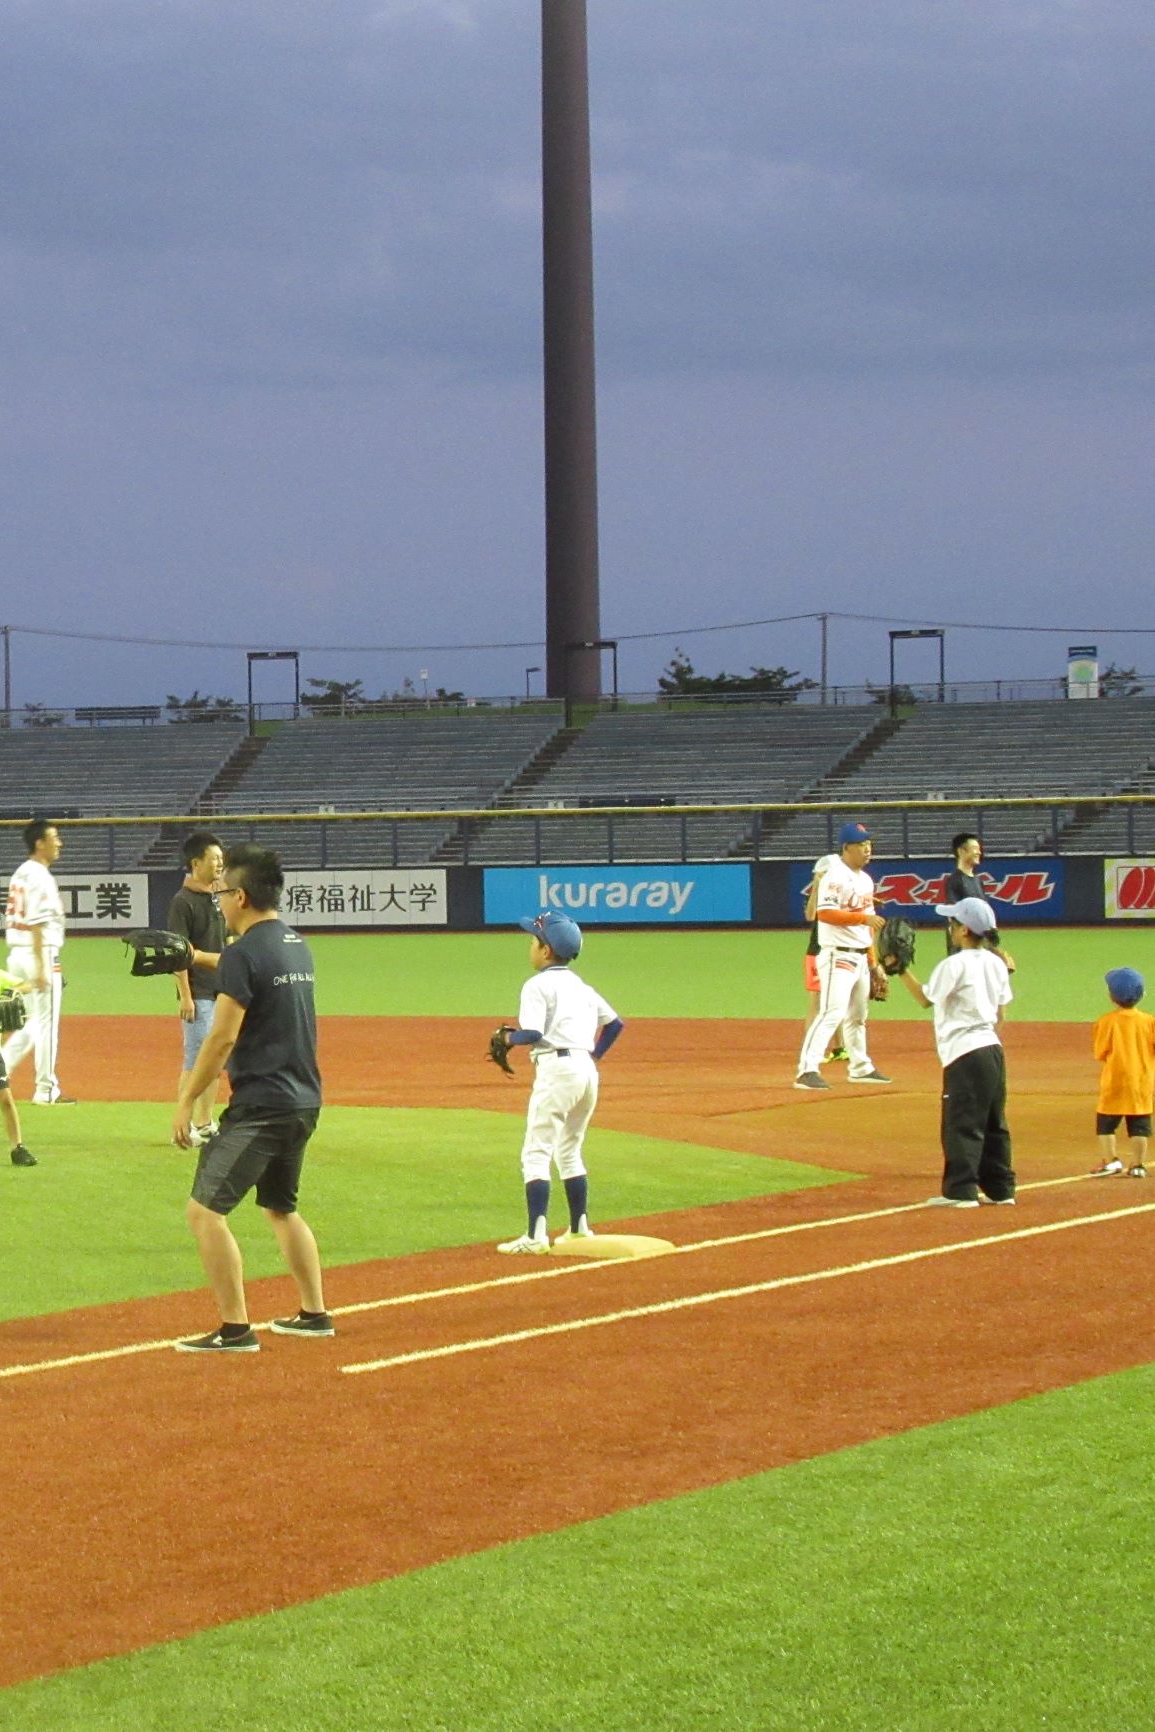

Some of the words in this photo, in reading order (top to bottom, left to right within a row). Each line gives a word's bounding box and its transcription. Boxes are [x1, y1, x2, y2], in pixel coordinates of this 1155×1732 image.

[280, 883, 438, 914] 療福祉大学
[539, 875, 694, 914] kuraray
